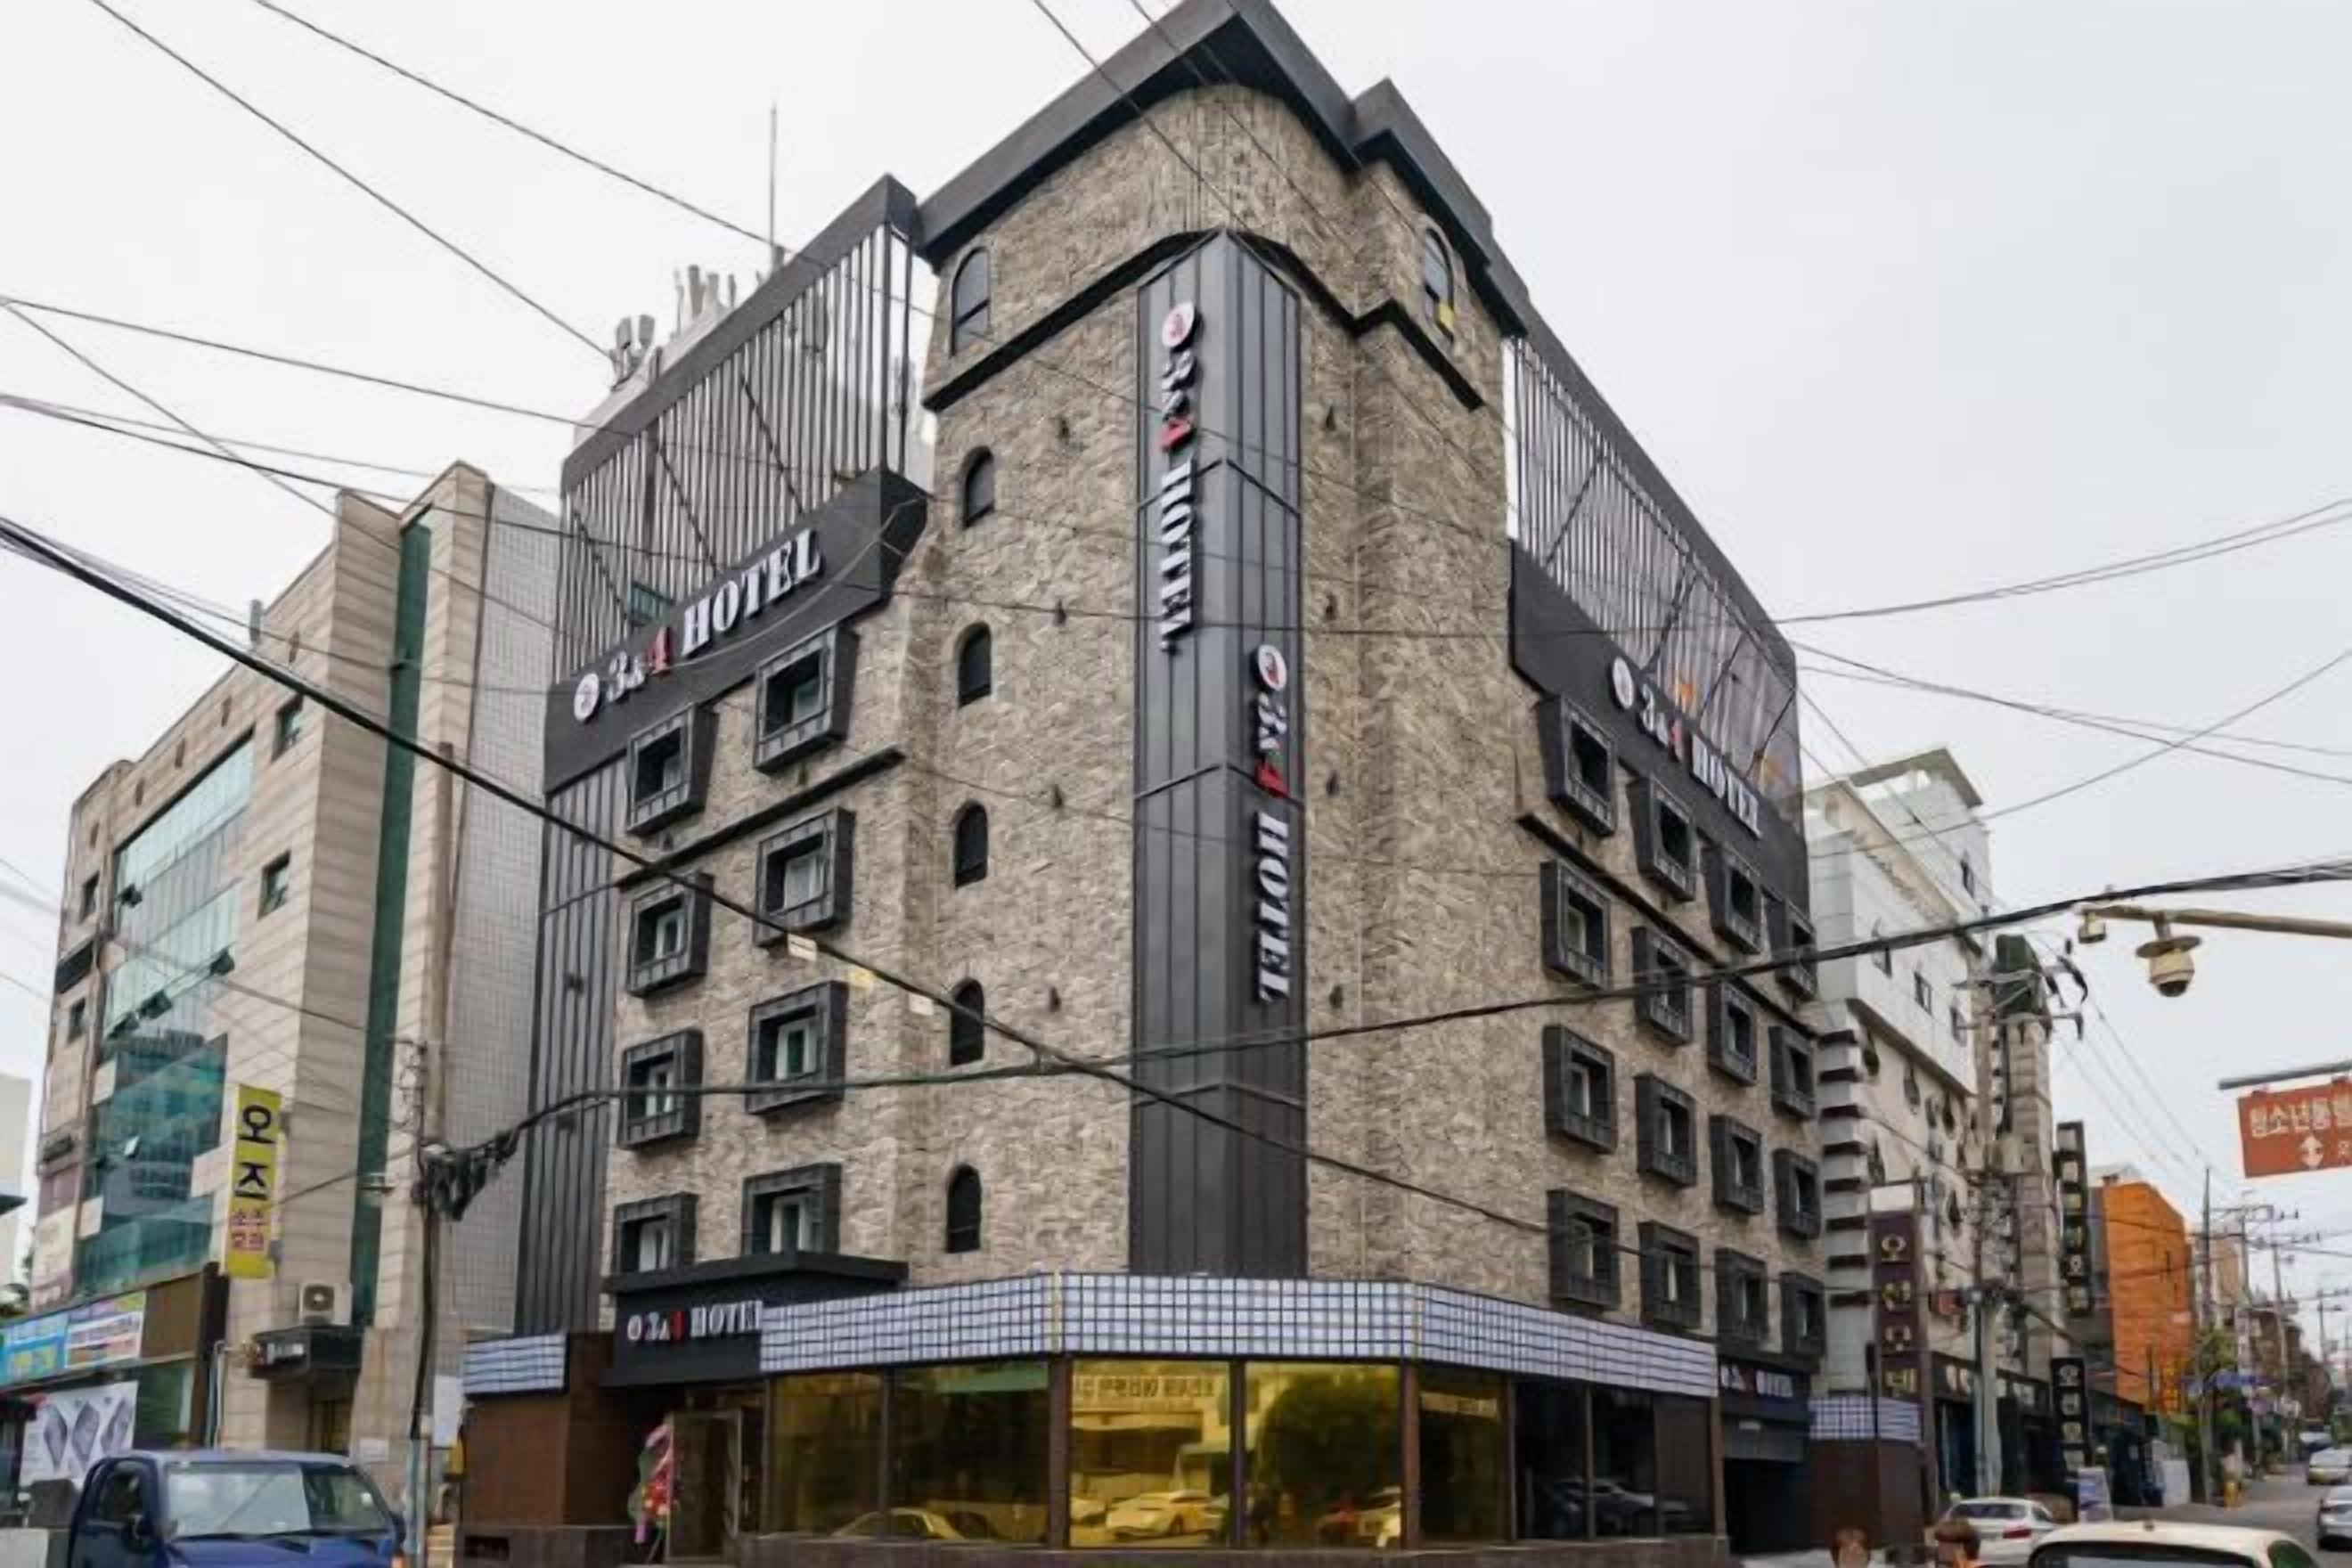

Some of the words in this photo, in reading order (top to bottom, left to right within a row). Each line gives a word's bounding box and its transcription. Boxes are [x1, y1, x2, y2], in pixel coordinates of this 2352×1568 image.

[681, 527, 821, 657] HOTEL
[1160, 457, 1193, 654] HOTEL
[1691, 732, 1763, 838] HOTEL
[1257, 811, 1290, 1003] HOTEL
